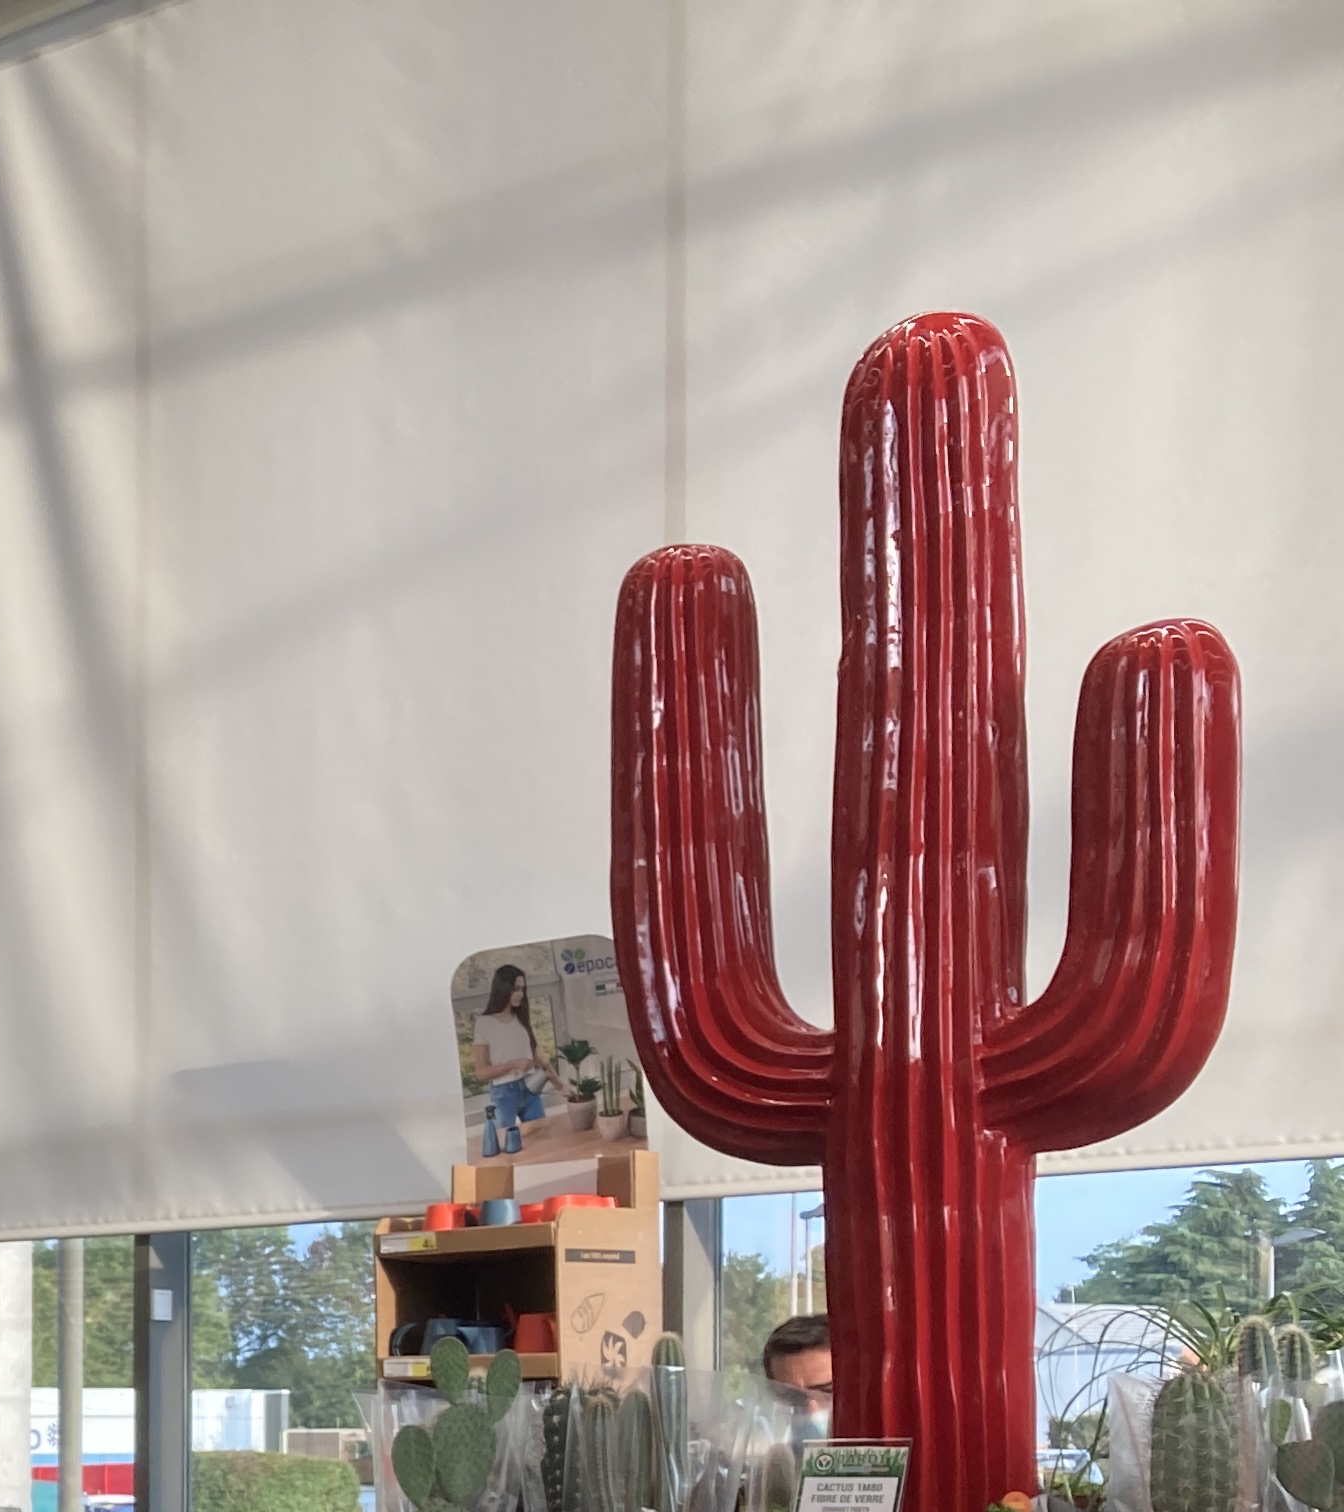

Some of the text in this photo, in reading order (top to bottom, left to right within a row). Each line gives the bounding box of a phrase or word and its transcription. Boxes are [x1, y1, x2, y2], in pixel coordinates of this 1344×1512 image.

[577, 956, 615, 976] epoc
[816, 1483, 854, 1492] CACTUS
[811, 1494, 885, 1504] FIBRE DE VERRE
